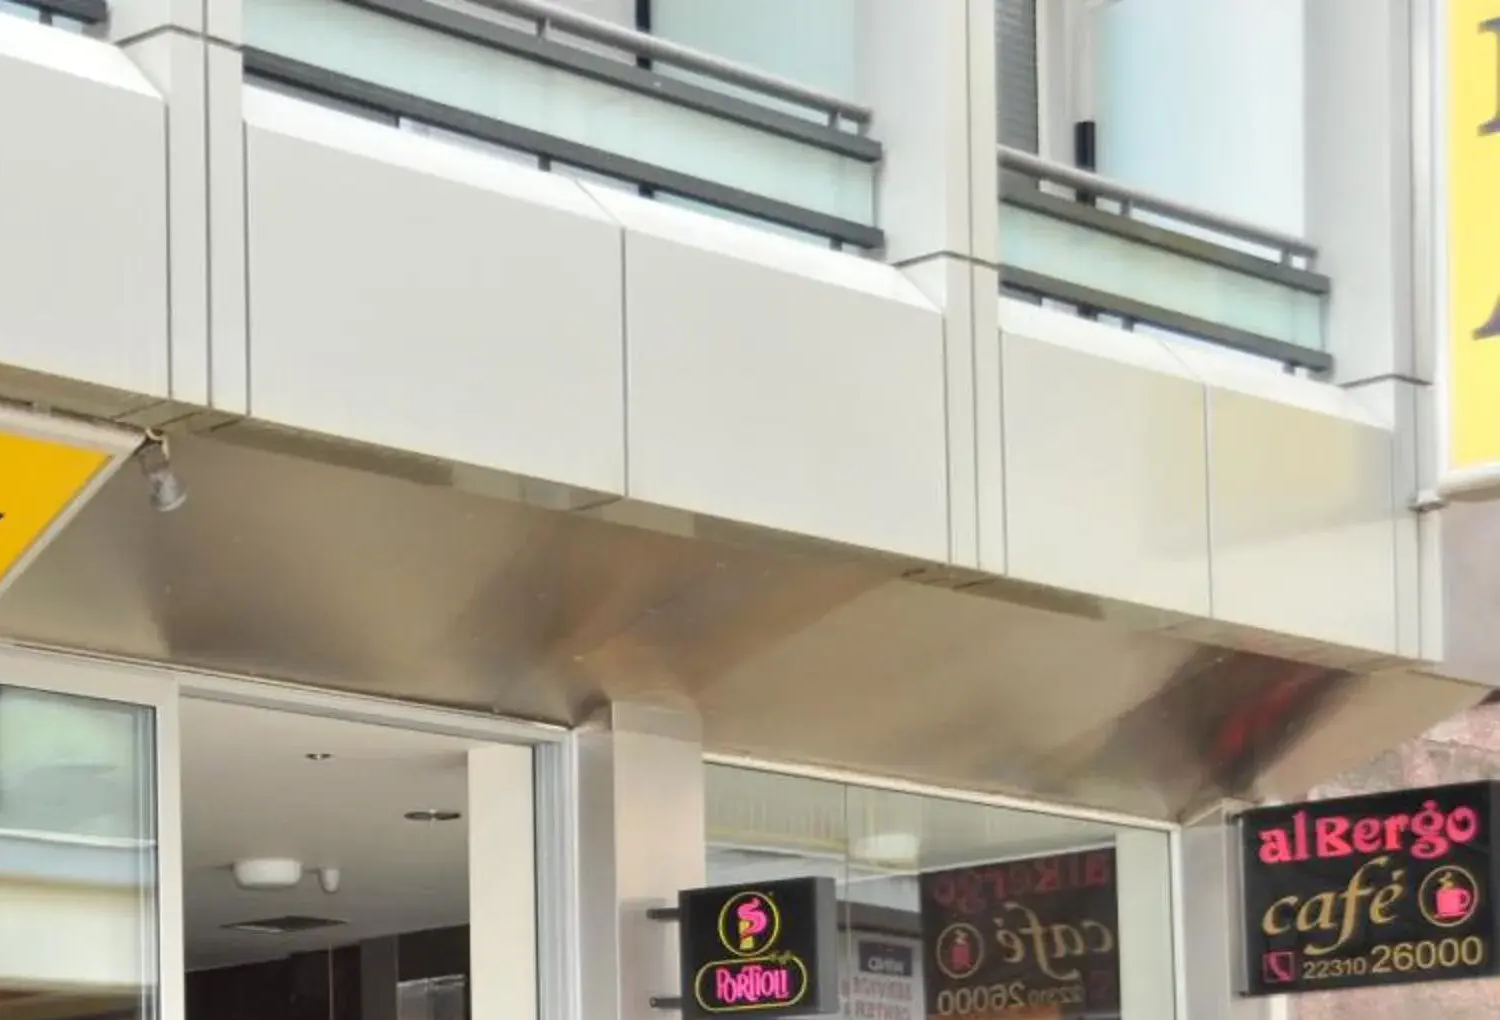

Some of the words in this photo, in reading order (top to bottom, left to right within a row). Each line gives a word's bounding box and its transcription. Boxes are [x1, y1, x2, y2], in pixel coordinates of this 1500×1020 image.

[1262, 856, 1405, 955] café
[1303, 956, 1367, 980] 22310
[1371, 936, 1483, 973] 26000
